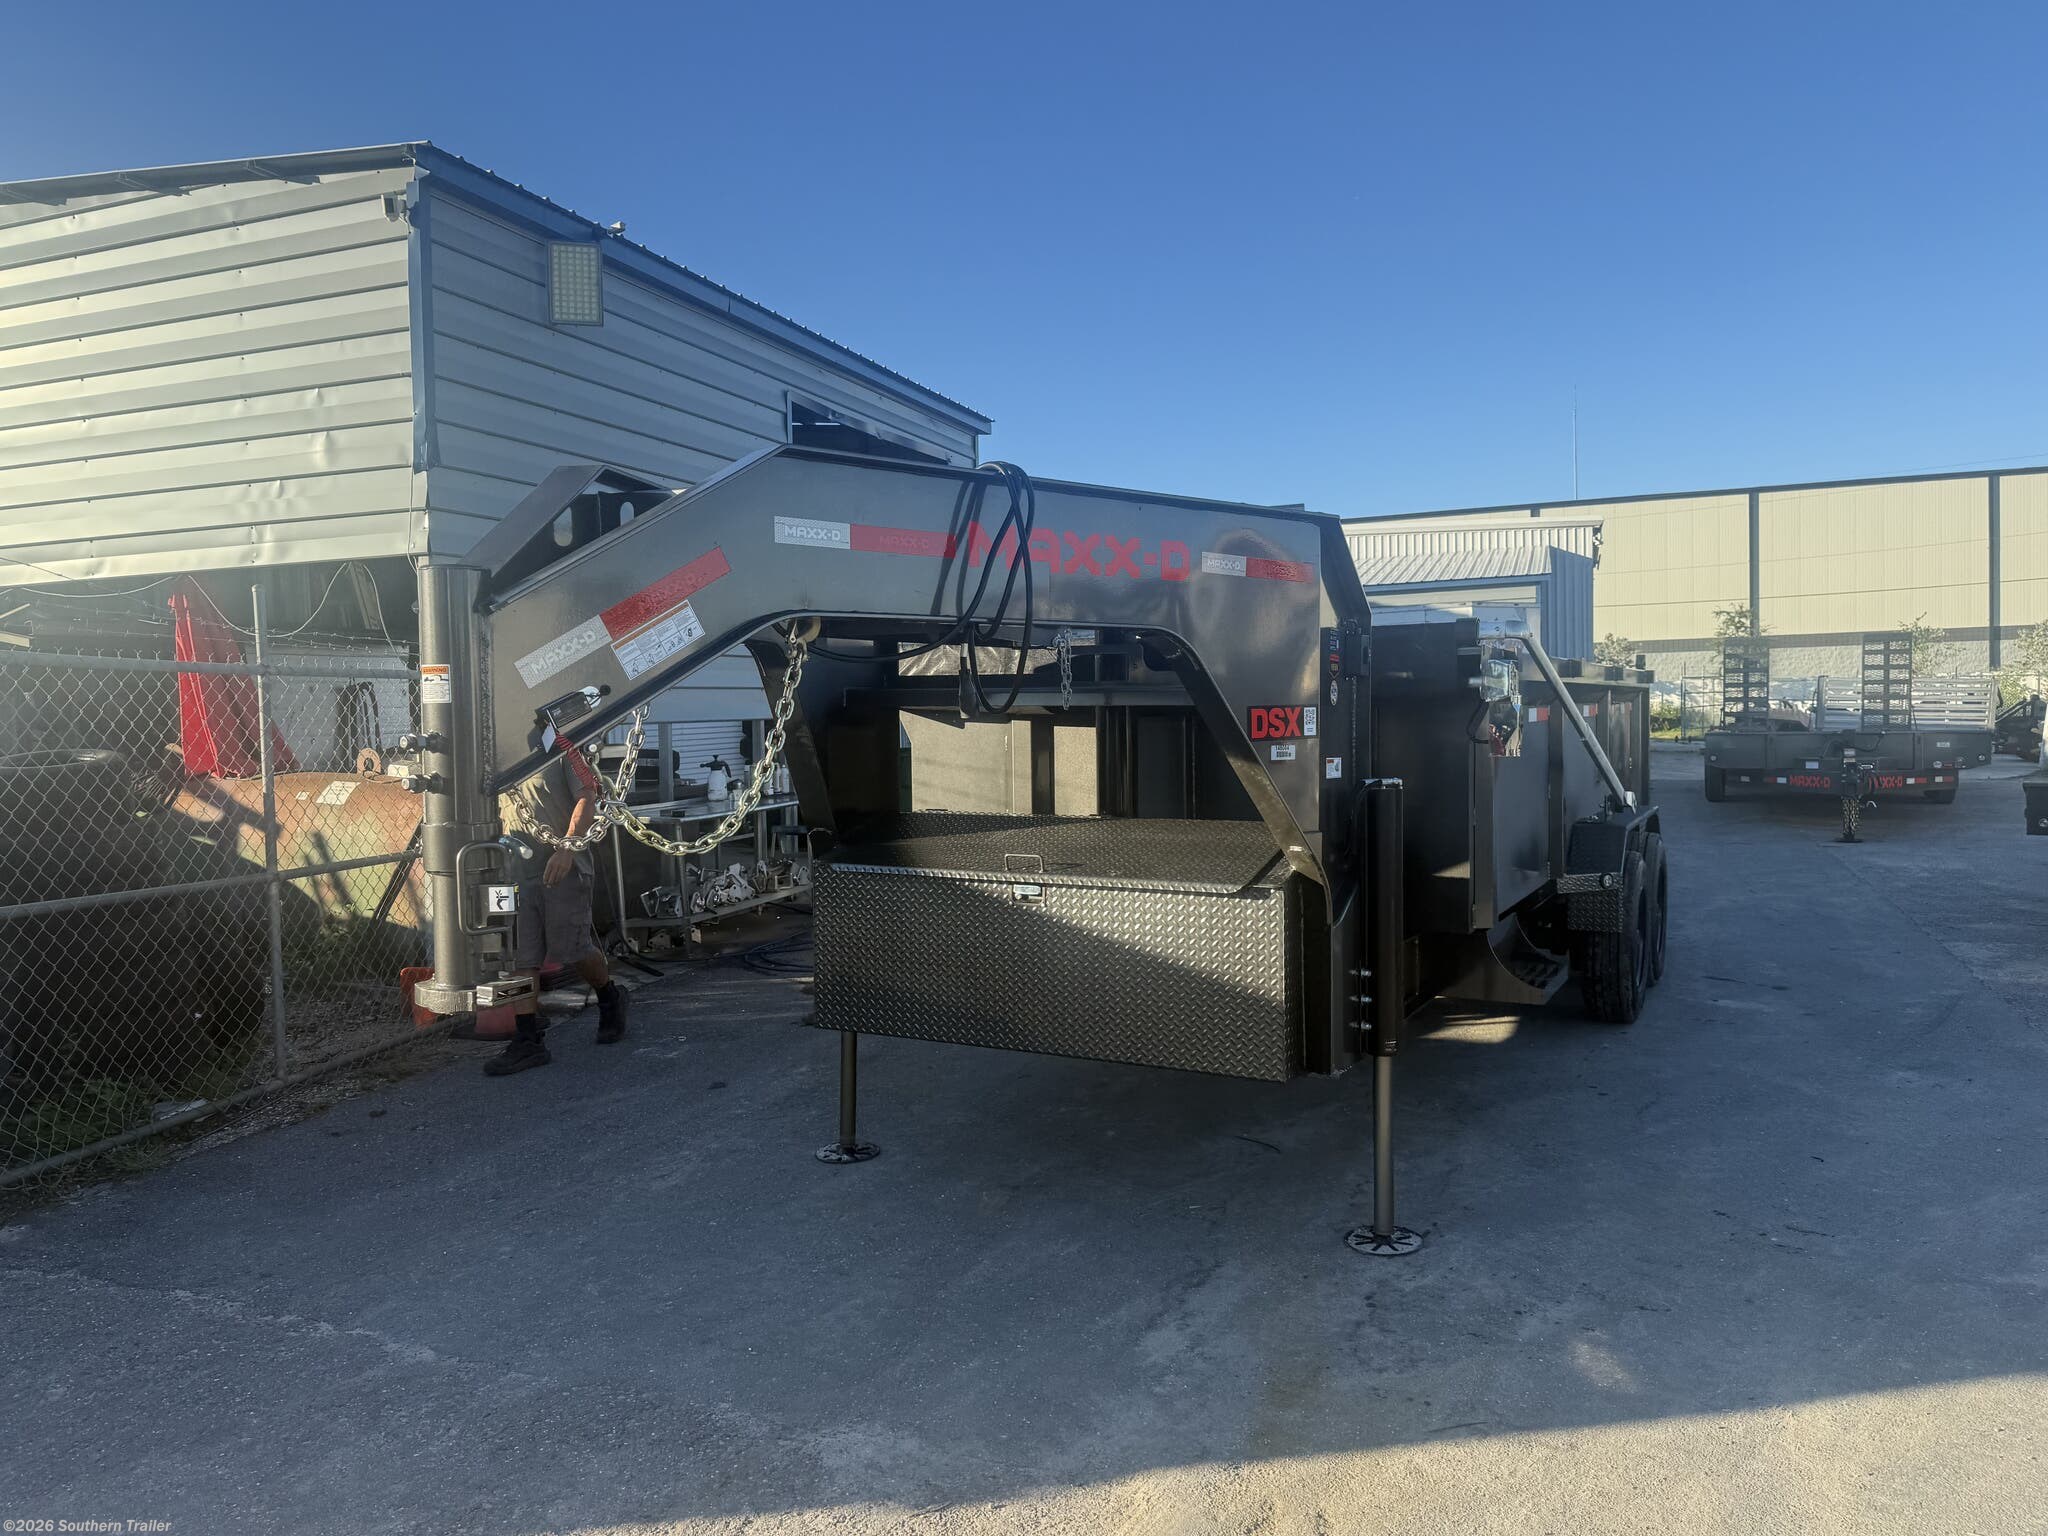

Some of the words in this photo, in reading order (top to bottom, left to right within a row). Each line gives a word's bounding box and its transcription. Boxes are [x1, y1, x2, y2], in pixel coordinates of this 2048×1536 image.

[784, 525, 841, 541] MAXX-D
[968, 520, 1191, 581] MAXX-D
[1251, 707, 1302, 739] DSX
